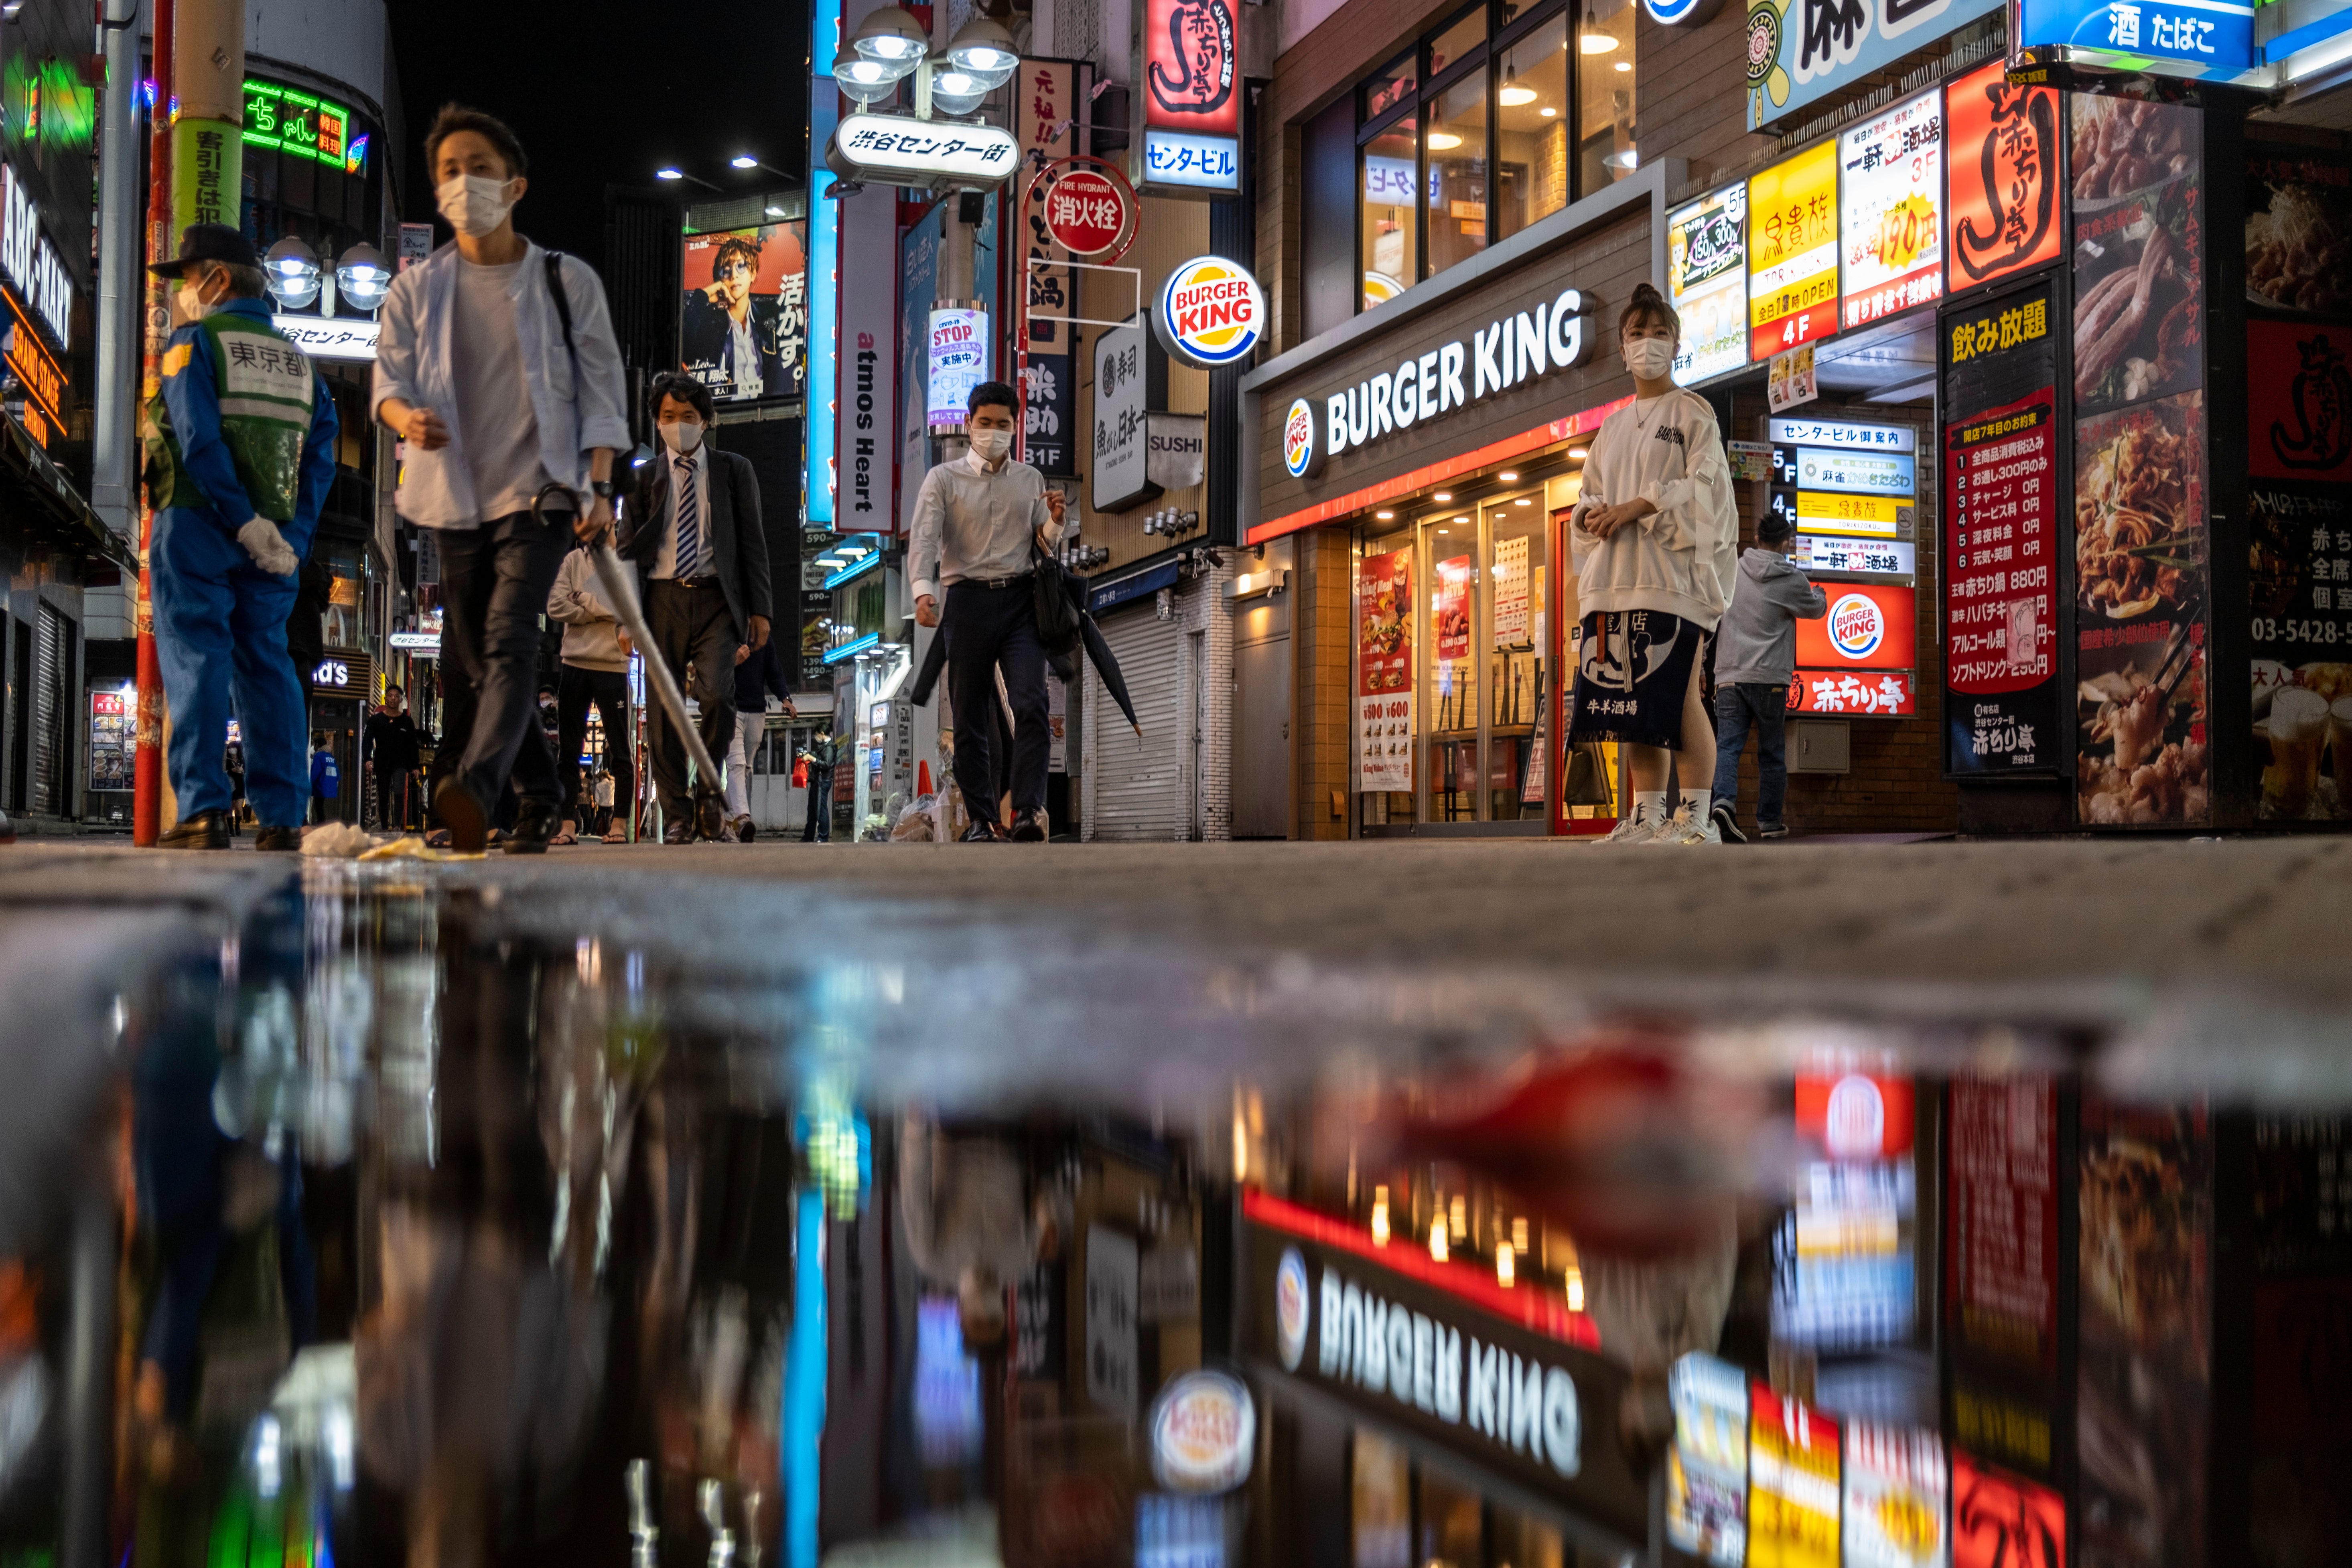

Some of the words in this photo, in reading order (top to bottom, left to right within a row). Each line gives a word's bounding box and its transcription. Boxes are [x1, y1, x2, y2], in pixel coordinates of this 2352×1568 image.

[2108, 2, 2141, 48] 酒
[2151, 14, 2215, 54] たばこ
[1186, 7, 1217, 103] 赤ちり亭
[248, 96, 316, 142] ちゃん
[320, 114, 341, 136] 韓国
[319, 135, 341, 156] 料理
[849, 130, 1010, 162] 渋谷センター街
[1148, 144, 1235, 176] センタービル
[1912, 150, 1936, 183] 3F
[1059, 181, 1075, 191] FIRE
[1078, 183, 1110, 194] HYDRANT
[2001, 118, 2036, 251] 赤ちり亭
[1053, 196, 1118, 231] 消火栓
[2, 163, 71, 351] ABC-MART
[907, 231, 933, 276] 白い恋人
[1176, 281, 1248, 311] BURGER
[777, 271, 804, 380] 活かす。
[939, 319, 960, 328] COVID-19
[1178, 299, 1252, 337] KING
[1783, 315, 1809, 344] 4F
[1952, 298, 2046, 363] 飲み放題
[934, 325, 972, 346] STOP
[13, 321, 38, 387] GRAND
[39, 357, 59, 415] STAGE
[228, 341, 307, 377] 東京都
[942, 353, 972, 367] 実施中
[1116, 344, 1136, 387] 寿司
[1328, 342, 1465, 455] BURGER
[1475, 289, 1582, 398] KING
[856, 332, 878, 431] atmos
[1025, 363, 1059, 436] 米助
[24, 400, 47, 450] SHIBUYA
[1096, 404, 1146, 460] 魚がし日本一
[1784, 425, 1898, 444] センタービル御案内
[1964, 413, 2037, 443] 開店7年目のお約束
[1149, 436, 1203, 453] SUSHI
[1287, 424, 1307, 456] KING
[1972, 436, 2044, 467] 全商品消費税込み
[1025, 448, 1060, 465] B1F
[1106, 458, 1118, 470] STANDING
[855, 437, 875, 513] Heart
[1823, 470, 1845, 483] 麻雀
[1847, 471, 1910, 487] かめきたざわ
[1973, 457, 2048, 487] お通し300円のみ
[1973, 486, 2012, 506] チャージ
[2022, 478, 2039, 495] 0円
[1973, 501, 2017, 523] サービス料
[2023, 497, 2039, 514] 0円
[806, 533, 826, 543] 590
[1839, 521, 1877, 529] TORIKIZOKU
[1973, 523, 2013, 545] 深夜料金
[2023, 519, 2039, 535] 0円
[1814, 552, 1898, 571] 一軒め酒場
[1973, 546, 2012, 567] 元気・笑顔
[2023, 540, 2039, 556] 0円
[1362, 582, 1376, 596] King
[1377, 577, 1393, 593] Meal
[1443, 582, 1465, 600] DEVIL
[1951, 582, 1964, 598] 王者
[1966, 572, 2005, 598] 赤ちり鍋
[2010, 566, 2047, 590] 880円
[1837, 609, 1874, 628] BURGER
[1839, 618, 1875, 642] KING
[1952, 609, 1965, 624] 激辛
[1952, 628, 2006, 655] アルコール類
[2080, 621, 2170, 650] 国産希少部位使用
[808, 666, 825, 674] 490
[1952, 658, 2006, 683] ソフトドリンク
[2189, 623, 2206, 745] 博多もつ鍋
[2253, 667, 2307, 687] 大人気
[1386, 701, 1408, 718] ¥600
[1587, 698, 1638, 716] 牛羊酒場
[1812, 676, 1905, 714] 赤ちり亭
[1975, 715, 2015, 728] 渋谷センター街
[1973, 724, 2036, 755] 赤ちり亭
[1364, 764, 1373, 775] King
[2012, 754, 2035, 764] 渋谷本店
